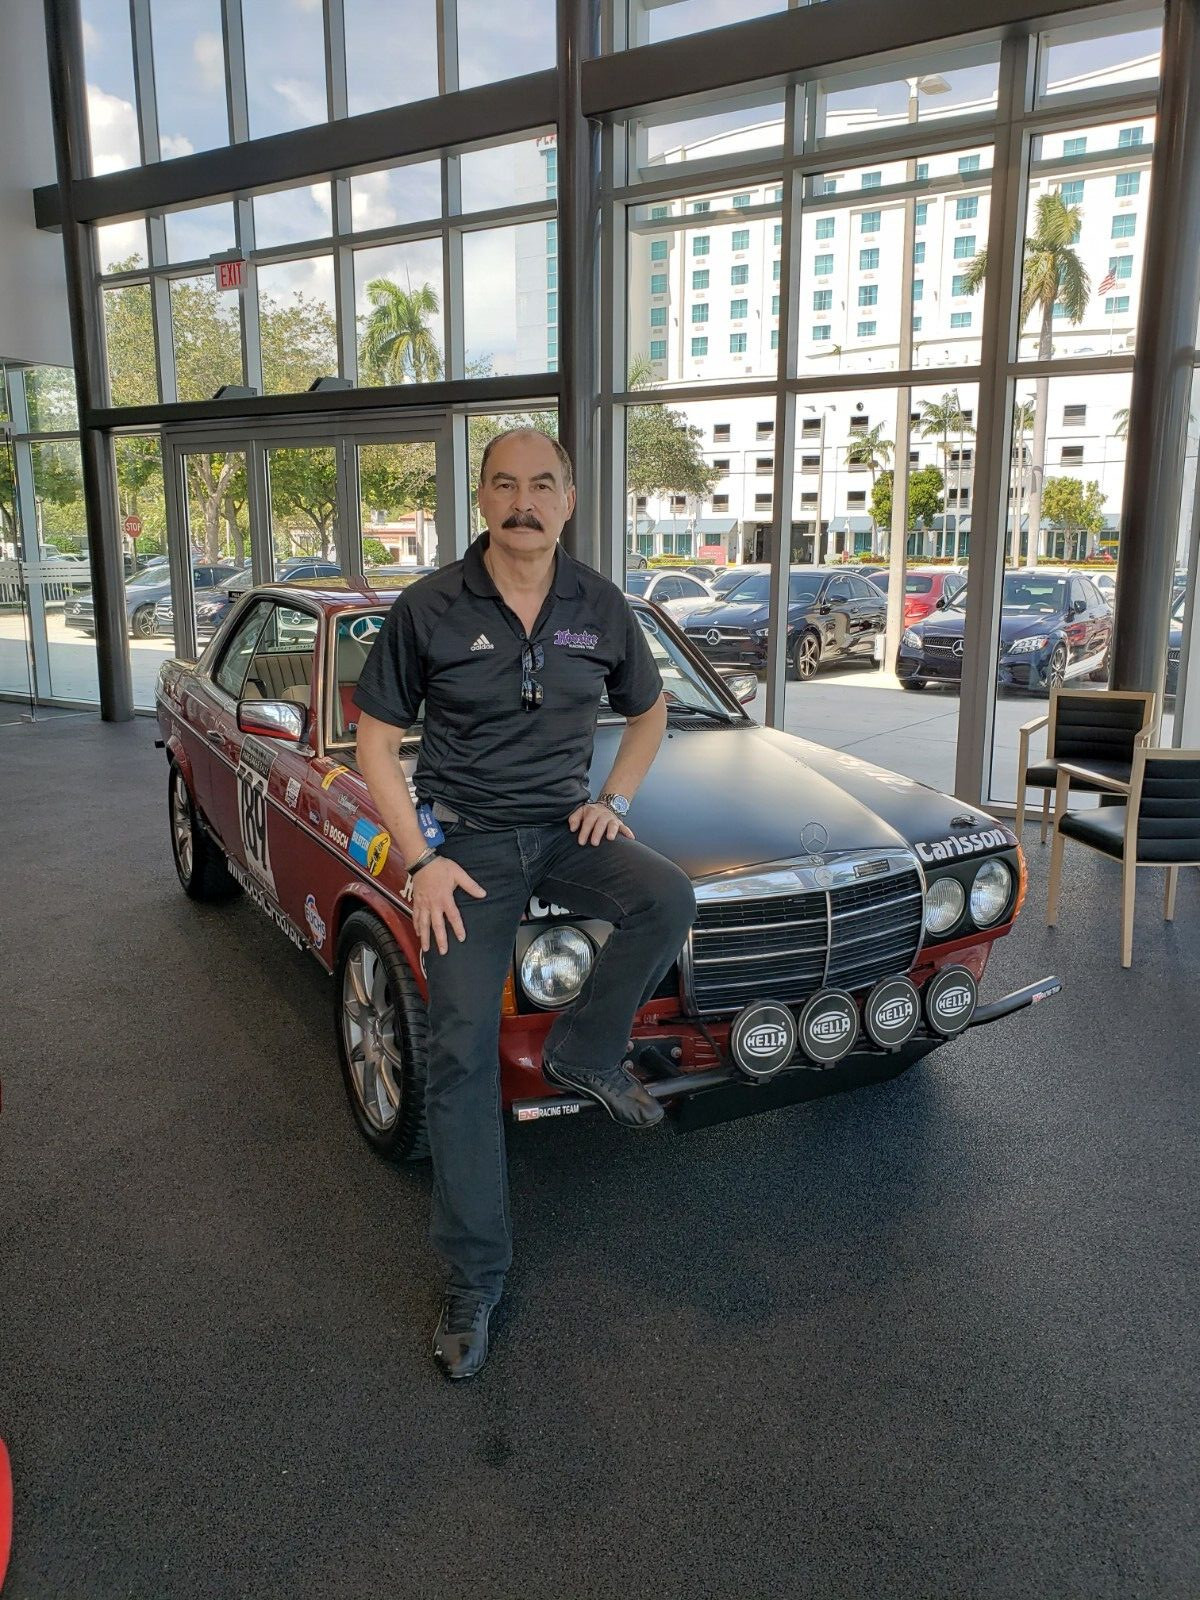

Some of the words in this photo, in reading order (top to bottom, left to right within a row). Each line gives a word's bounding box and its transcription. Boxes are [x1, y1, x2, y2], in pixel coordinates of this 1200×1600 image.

[220, 263, 241, 287] EXIT
[470, 643, 494, 651] adidas
[329, 825, 349, 850] BOSCH
[915, 828, 1007, 862] Carlsson
[939, 992, 971, 1008] HELLA
[878, 1004, 913, 1022] HELLA
[812, 1018, 850, 1035] HELLA
[747, 1034, 787, 1047] HELLA
[540, 1106, 561, 1117] RACING
[562, 1104, 580, 1115] TEAM
